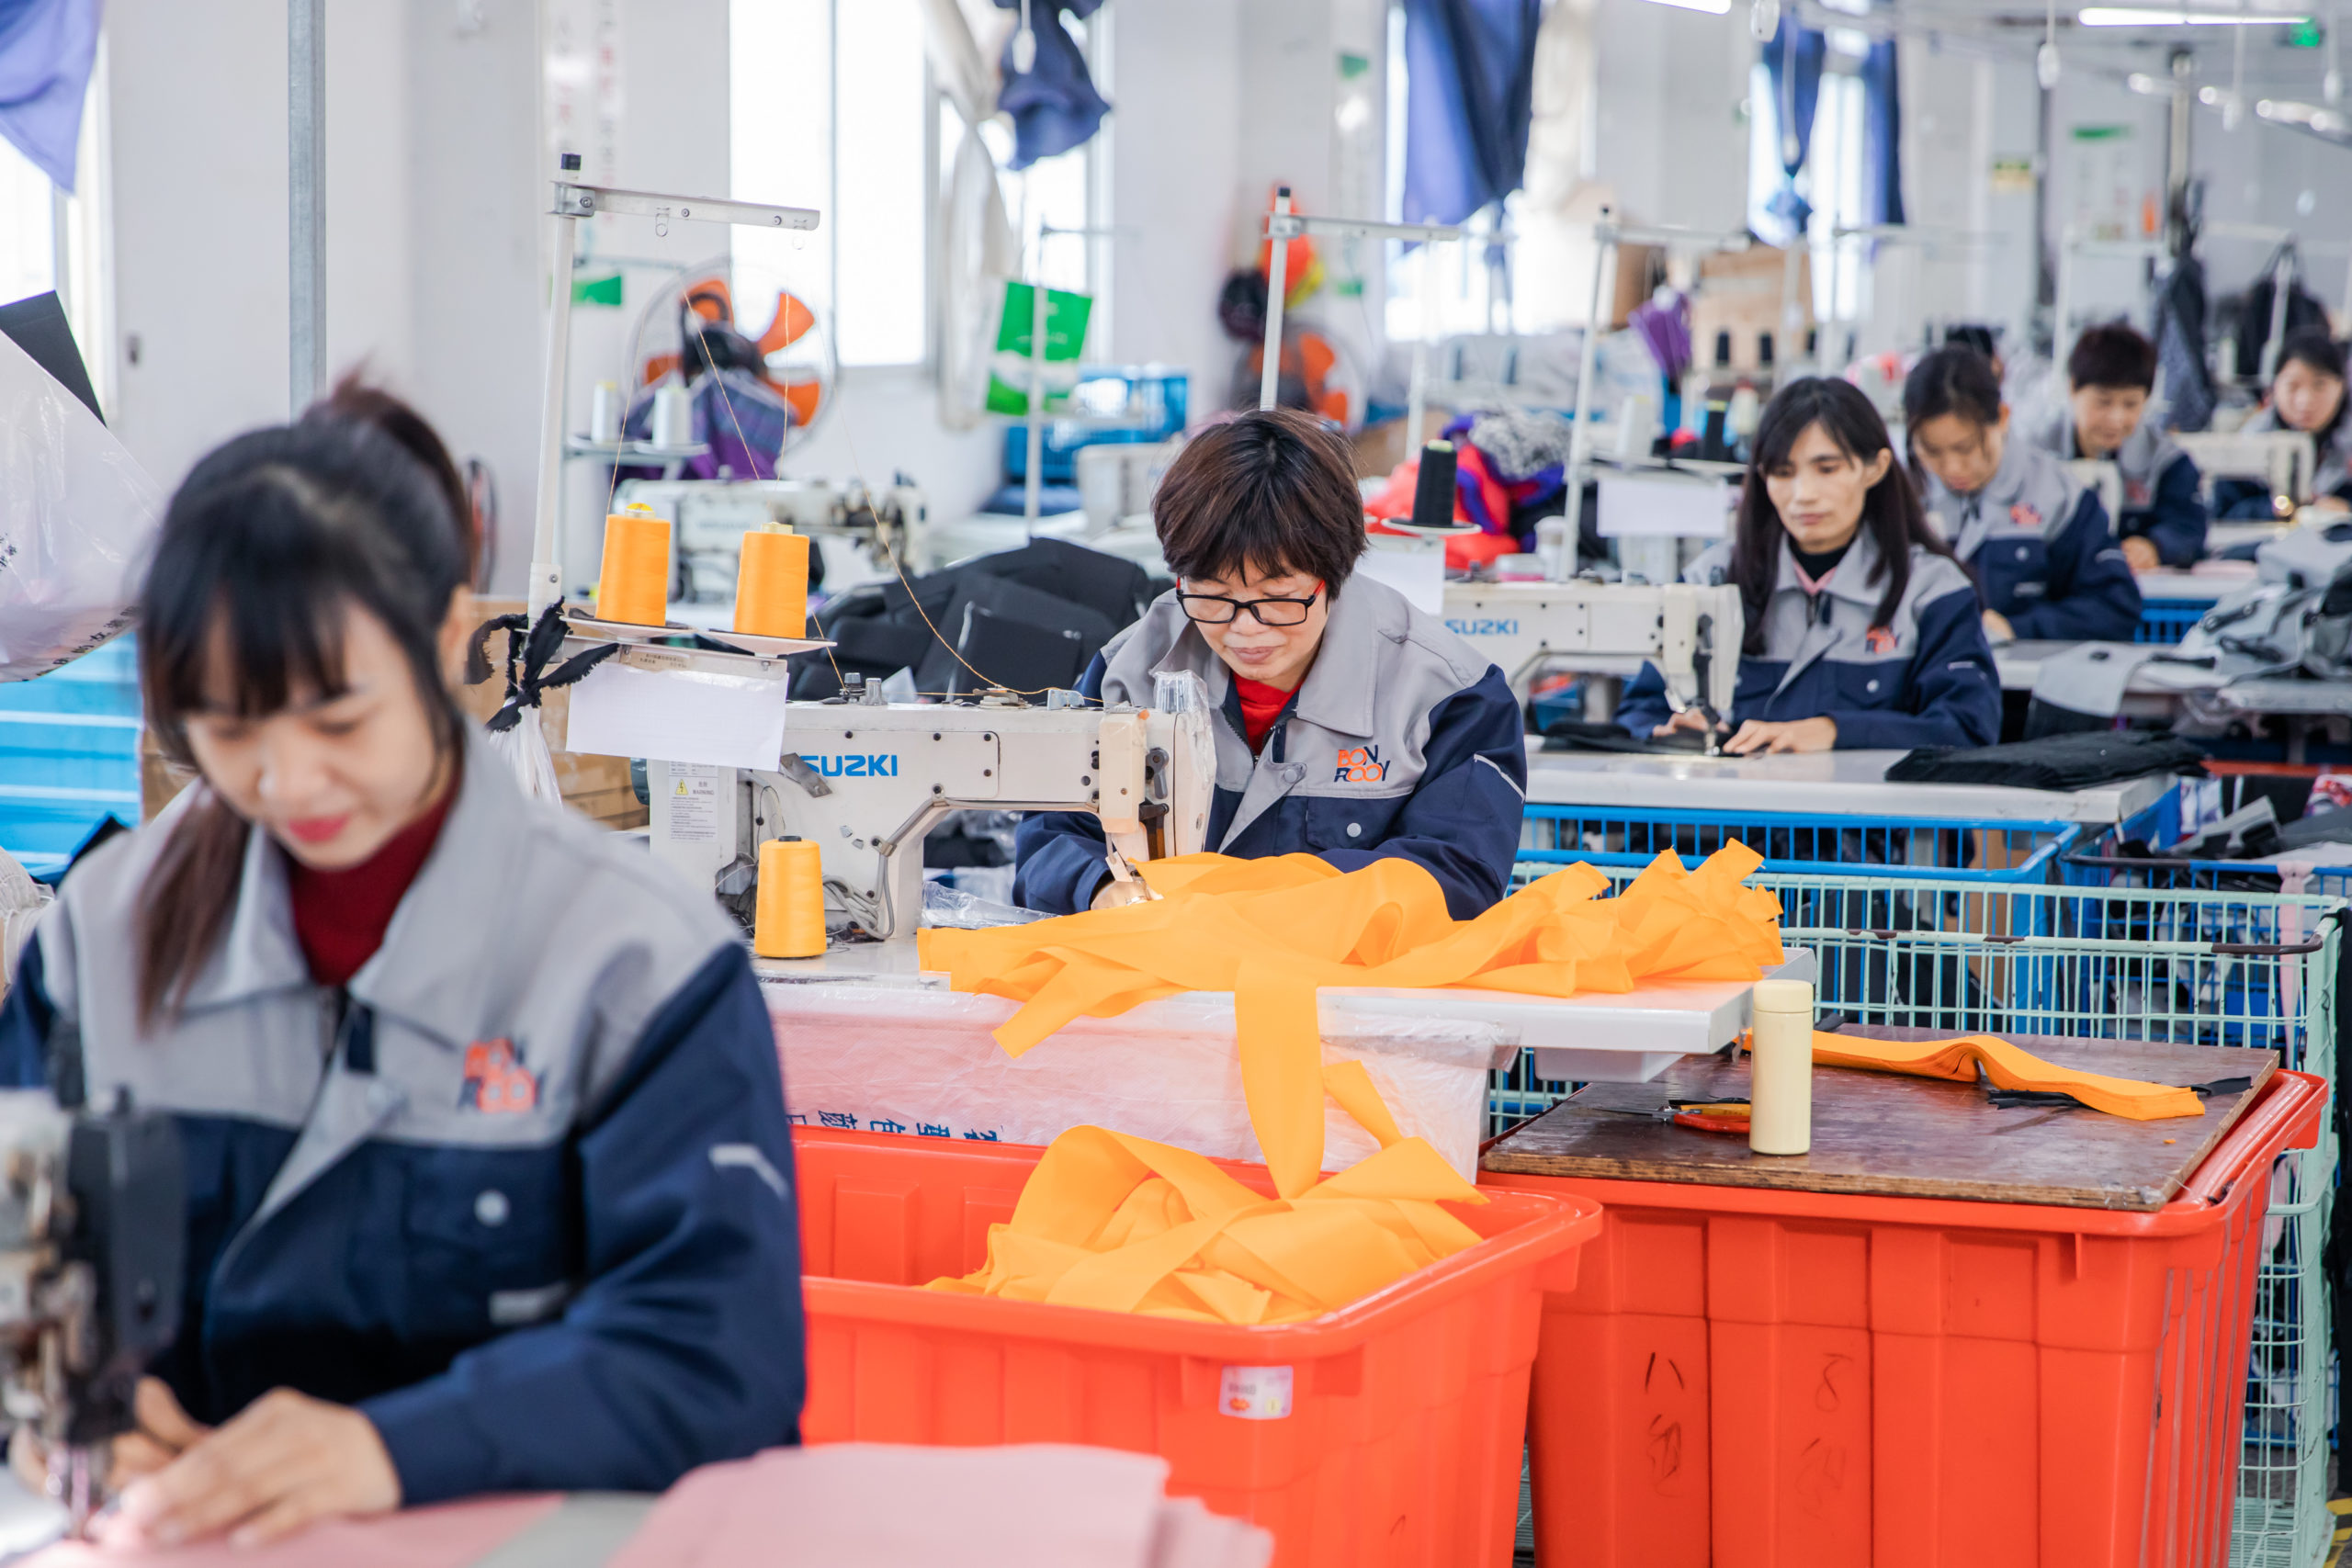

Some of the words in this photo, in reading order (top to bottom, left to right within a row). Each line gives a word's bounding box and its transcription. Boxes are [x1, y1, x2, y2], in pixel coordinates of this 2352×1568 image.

[1444, 619, 1519, 636] SUZKI
[1338, 745, 1379, 767] BON
[1334, 761, 1390, 783] ROOY
